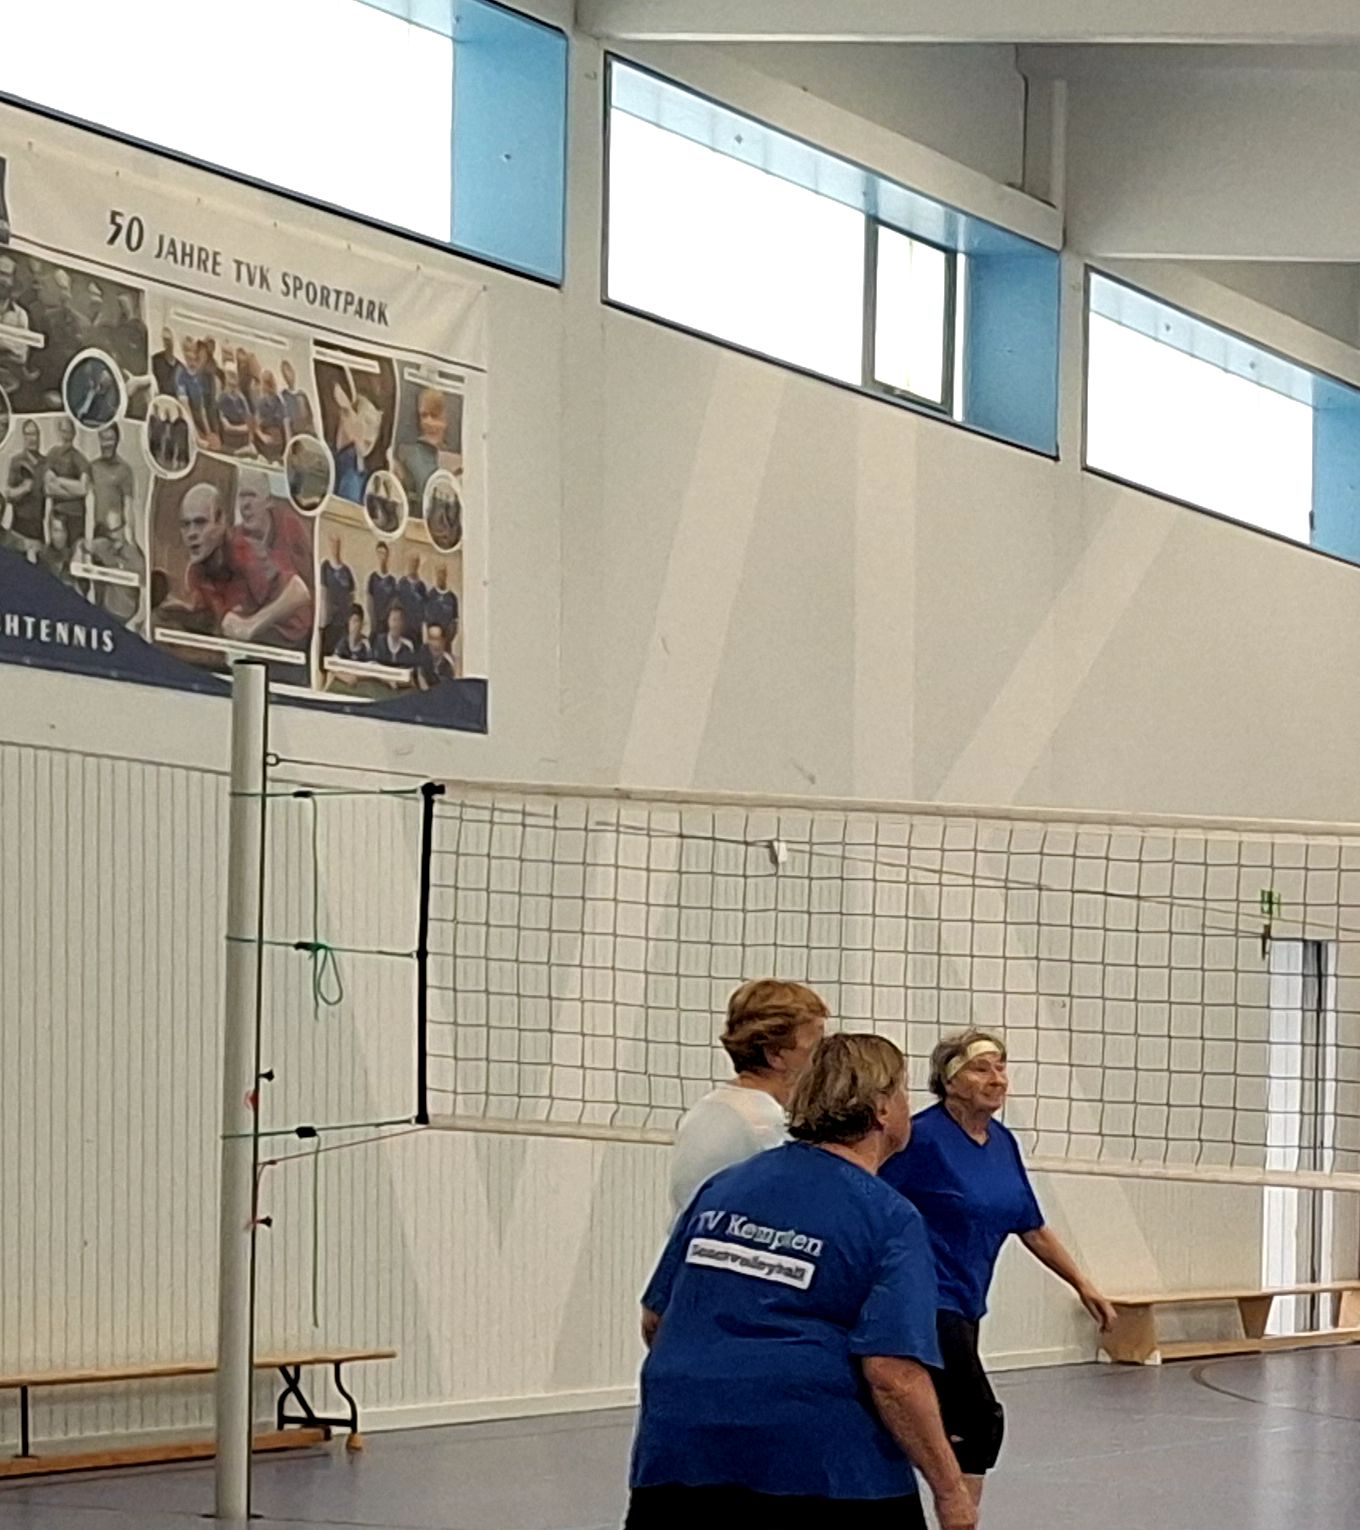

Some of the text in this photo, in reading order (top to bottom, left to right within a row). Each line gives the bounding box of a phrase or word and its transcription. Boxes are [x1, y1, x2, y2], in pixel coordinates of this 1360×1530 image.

[106, 210, 389, 327] 50 JAHRE TVK SPORTPARK
[0, 613, 114, 652] HTENNIS
[725, 1213, 823, 1257] Kempten
